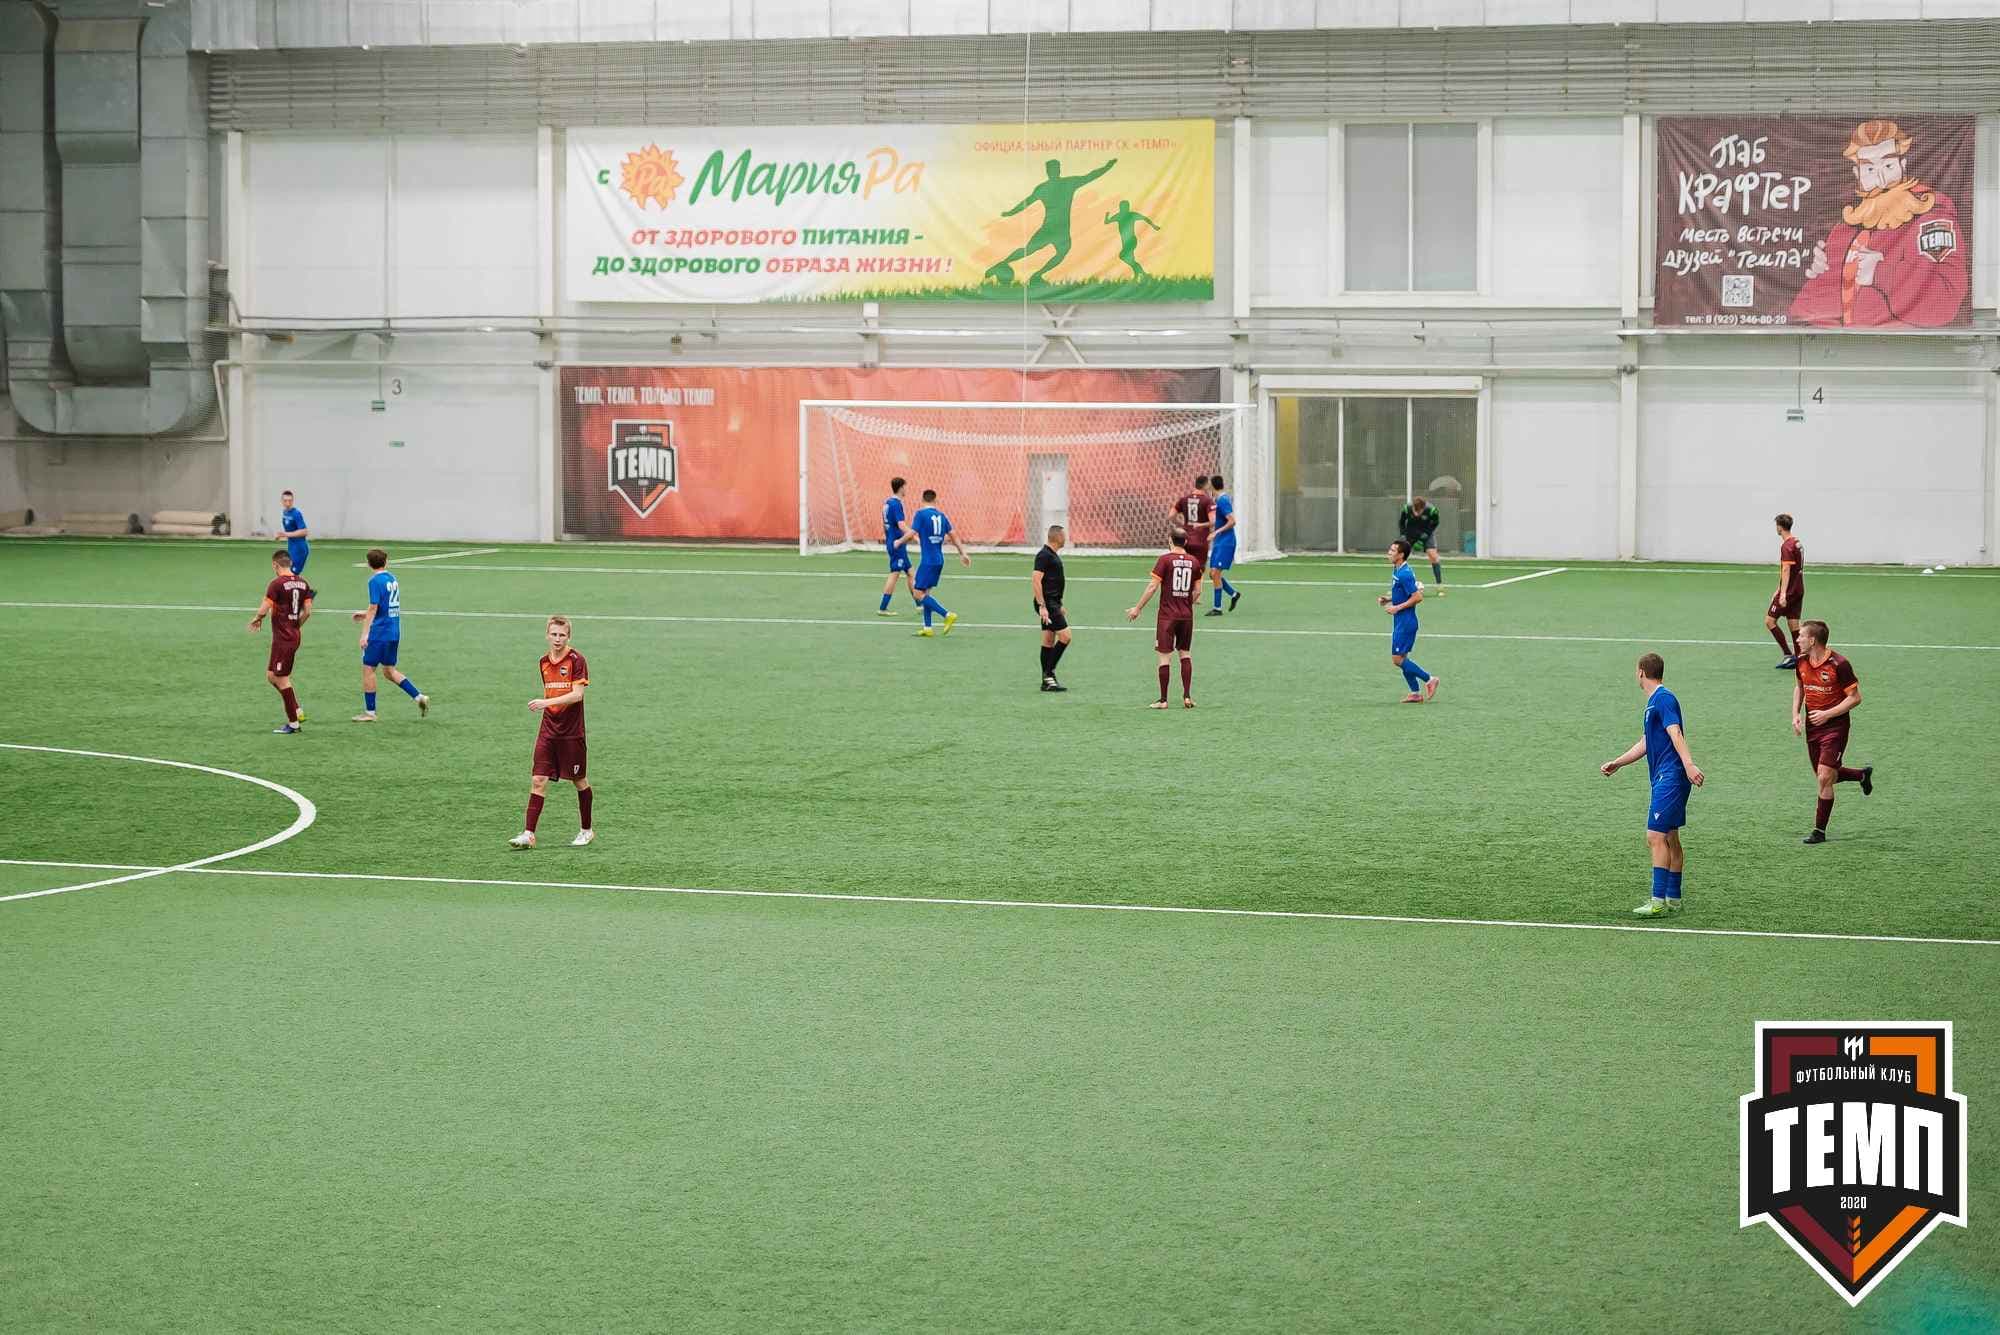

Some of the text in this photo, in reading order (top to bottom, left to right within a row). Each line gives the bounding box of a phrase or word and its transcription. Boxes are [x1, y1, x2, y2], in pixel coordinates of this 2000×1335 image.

[632, 230, 660, 245] ОТ
[664, 230, 797, 248] ЗДОРОВОГО
[801, 228, 910, 245] ПИТАНИЯ
[1921, 231, 1953, 250] ТЕМП
[592, 256, 625, 275] ДО
[628, 257, 761, 276] ЗДОРОВОГО
[765, 257, 850, 273] ОБРАЗА
[391, 378, 402, 396] 3
[1812, 386, 1824, 405] 4
[615, 447, 673, 482] ТЕМП
[931, 514, 942, 536] 11
[1172, 567, 1192, 592] 60
